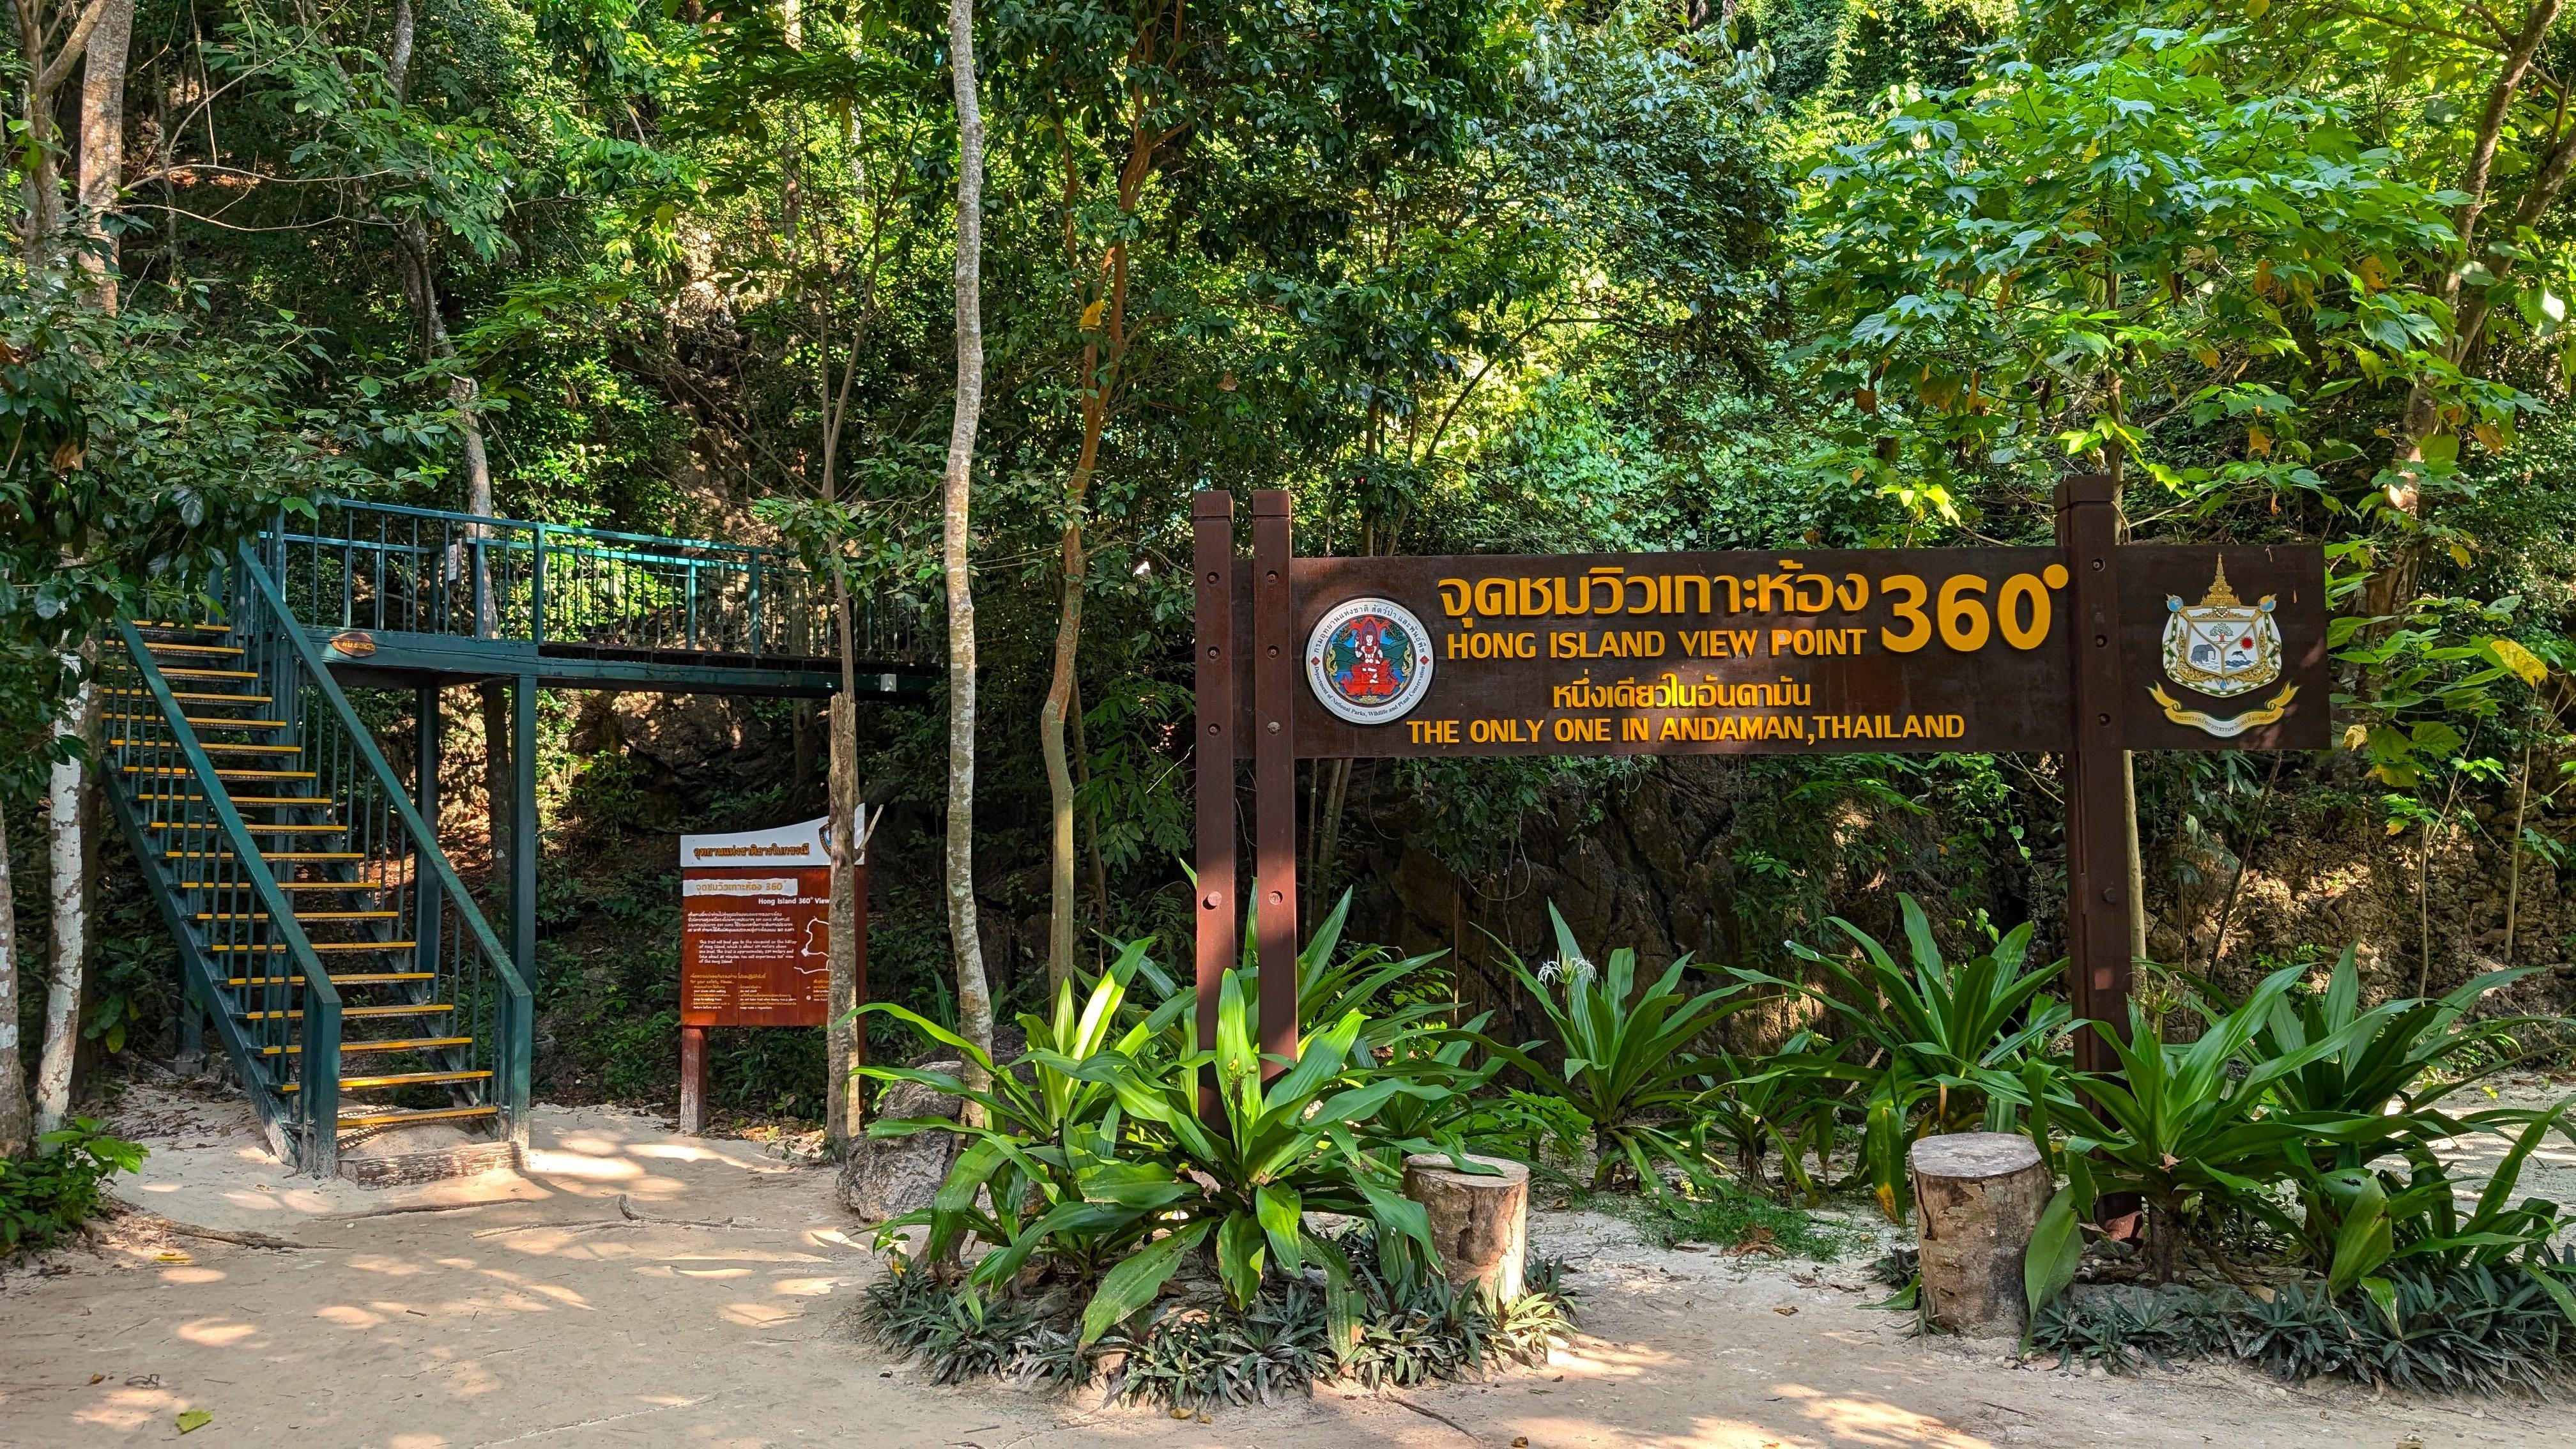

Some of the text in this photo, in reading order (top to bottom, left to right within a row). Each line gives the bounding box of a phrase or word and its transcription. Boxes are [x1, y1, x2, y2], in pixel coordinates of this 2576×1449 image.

[1438, 560, 1869, 629] จุดชมวิวเกาะห้อง
[1448, 629, 1867, 659] HONG ISLAND VIEW POINT
[1314, 666, 1329, 695] Department
[1331, 698, 1351, 712] National
[1398, 696, 1411, 707] Plant
[1552, 668, 1811, 709] หนึ่งเดียวในอันดามัน
[1406, 719, 1460, 744] THE
[1469, 719, 1544, 743] ONLY
[1554, 717, 1611, 742] ONE
[1622, 716, 1650, 741] IN
[758, 898, 776, 906] Hong
